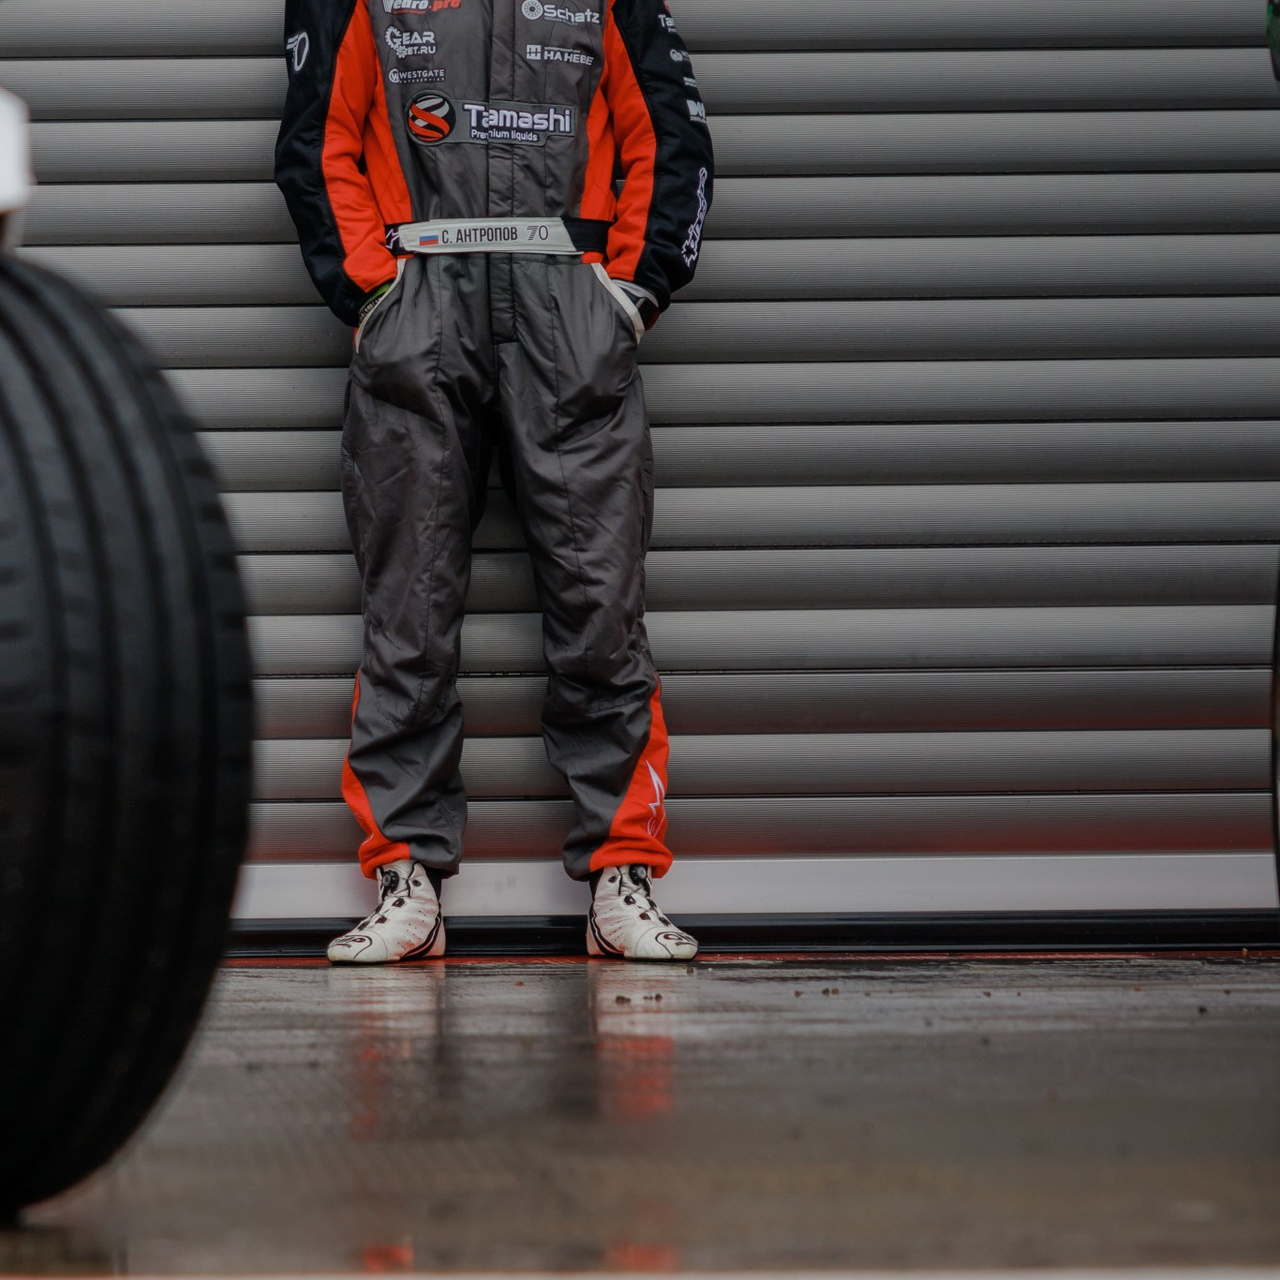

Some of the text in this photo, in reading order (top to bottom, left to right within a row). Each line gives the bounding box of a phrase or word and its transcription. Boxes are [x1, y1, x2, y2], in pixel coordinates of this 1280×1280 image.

[543, 4, 600, 24] Schatz
[543, 50, 563, 61] НА
[563, 52, 595, 66] НЕВЕ
[399, 69, 445, 80] WESTGATE
[463, 104, 571, 132] Tamashi
[471, 128, 538, 142] Premium liquids
[441, 225, 549, 244] С. АНТРОПОВ 70
